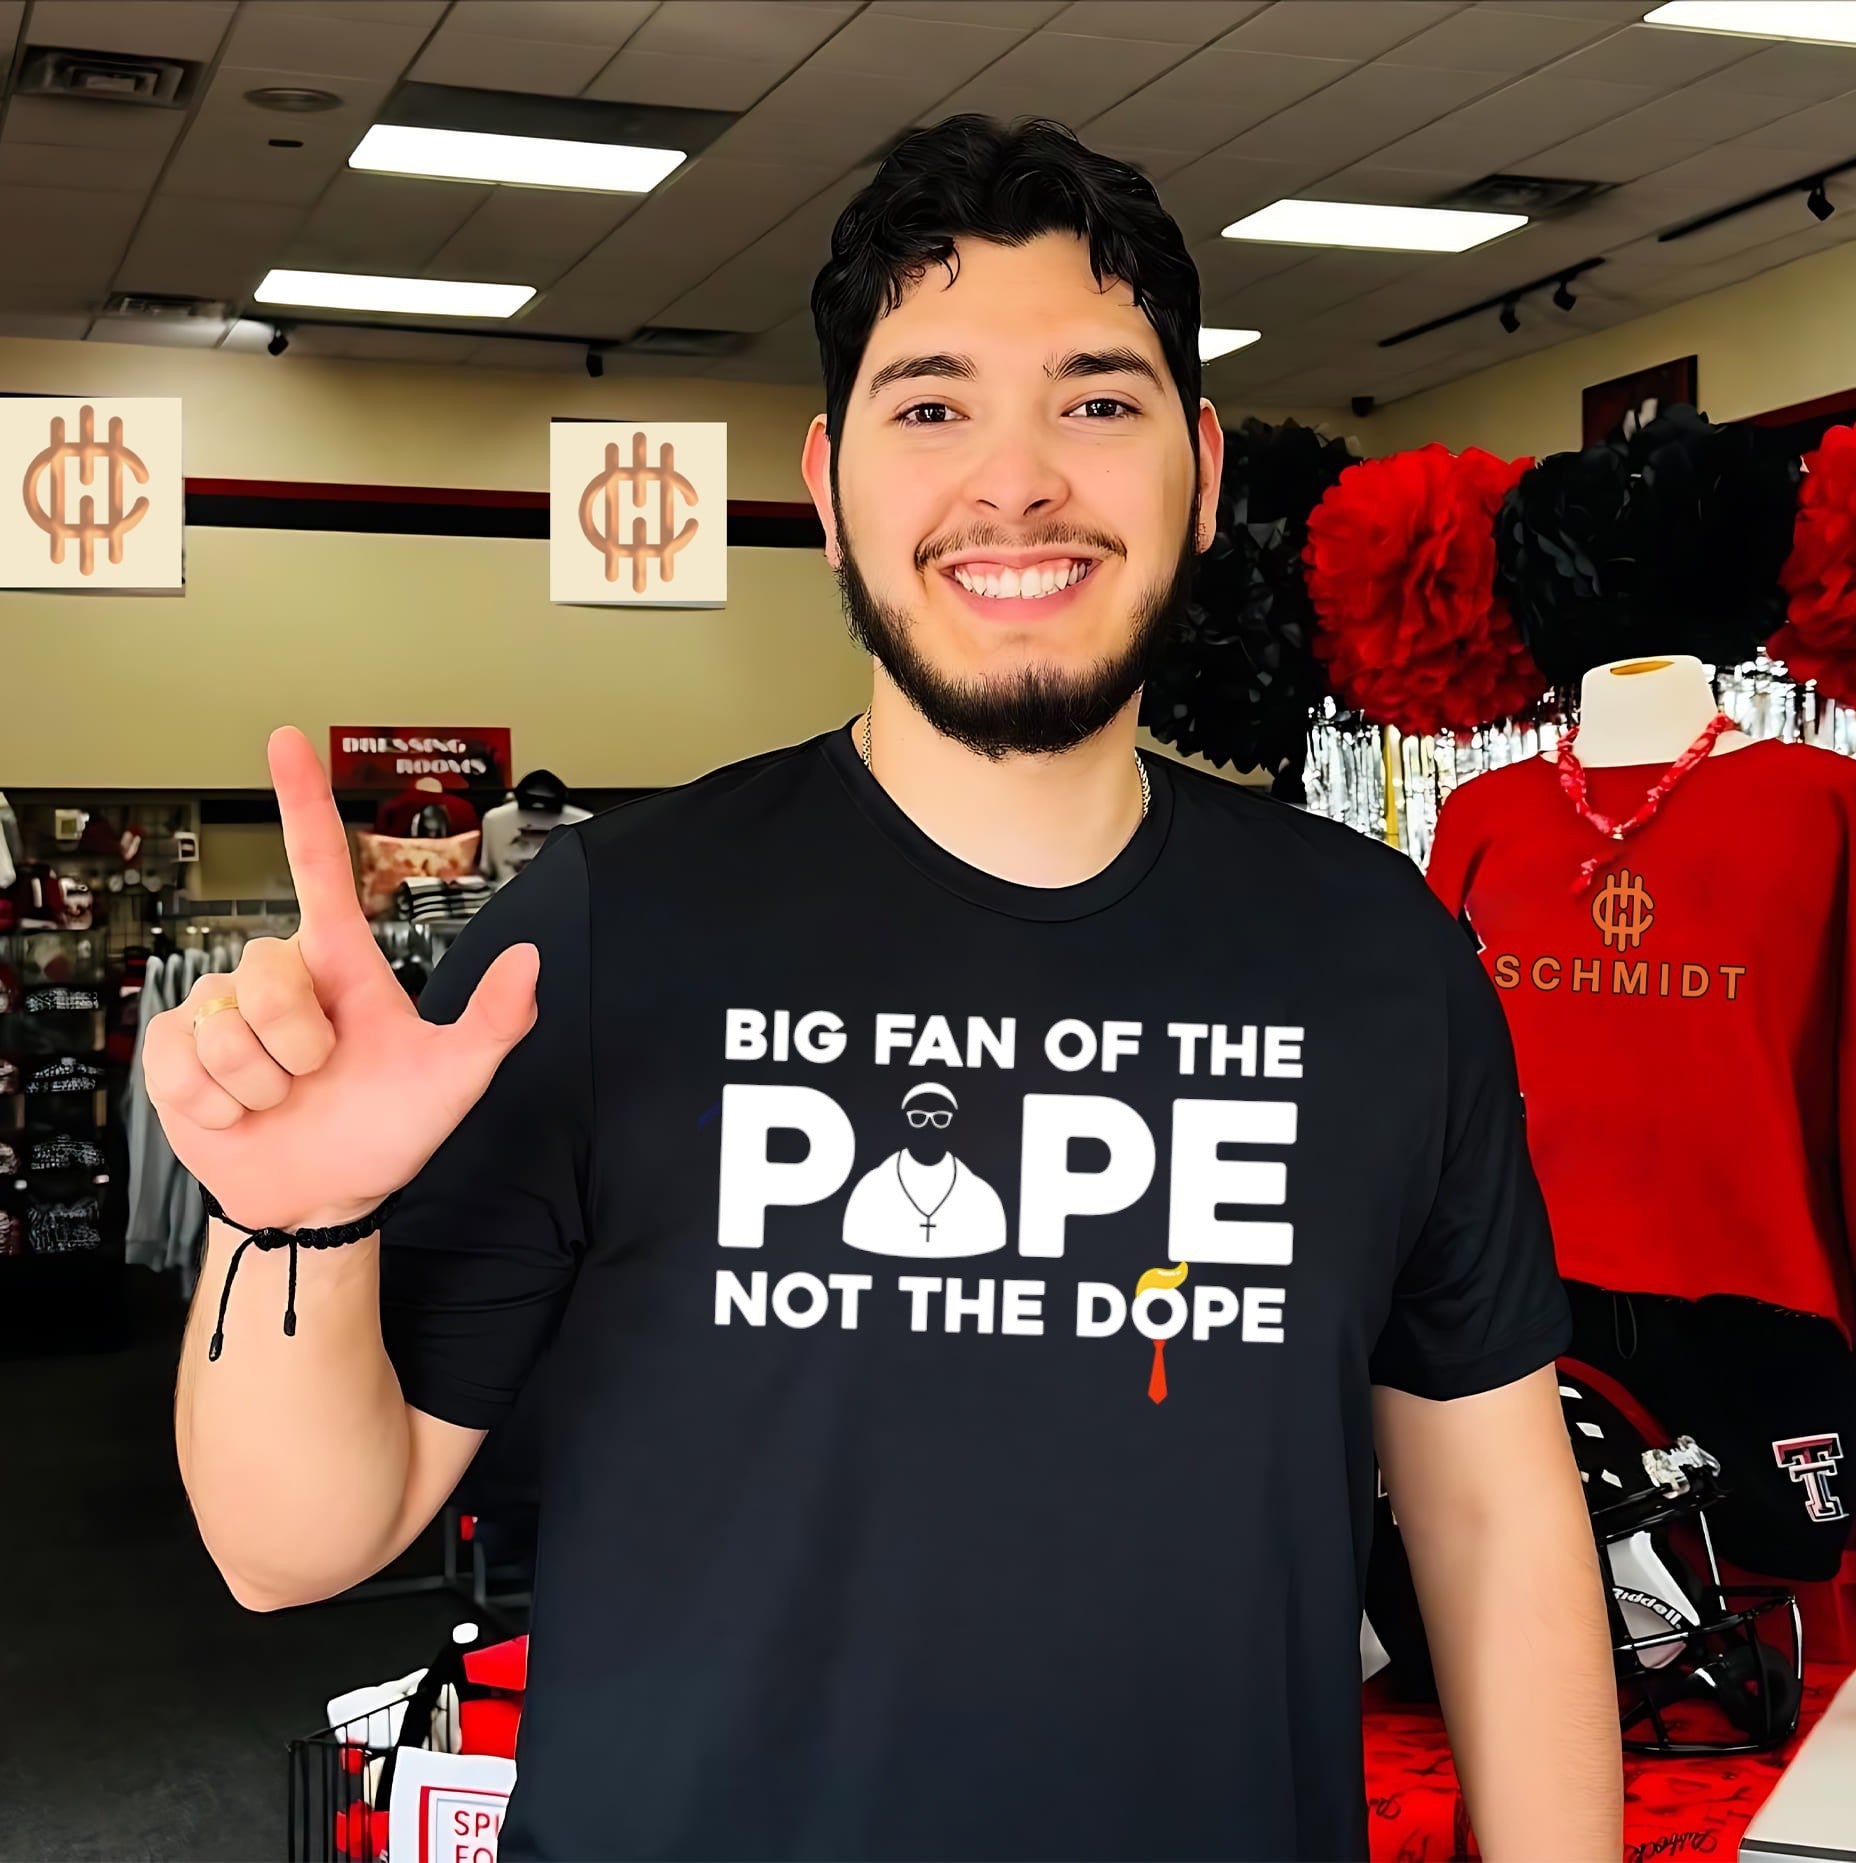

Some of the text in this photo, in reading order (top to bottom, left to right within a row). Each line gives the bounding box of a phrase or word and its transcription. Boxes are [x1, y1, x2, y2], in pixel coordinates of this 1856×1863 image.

[342, 737, 467, 754] DRESSING
[396, 758, 487, 776] ROOMS
[1494, 953, 1747, 1000] SCHMIDT
[725, 1008, 1305, 1079] BIG FAN OF THE
[717, 1082, 1299, 1267] PPE
[714, 1270, 1287, 1344] NOT THE DOPE
